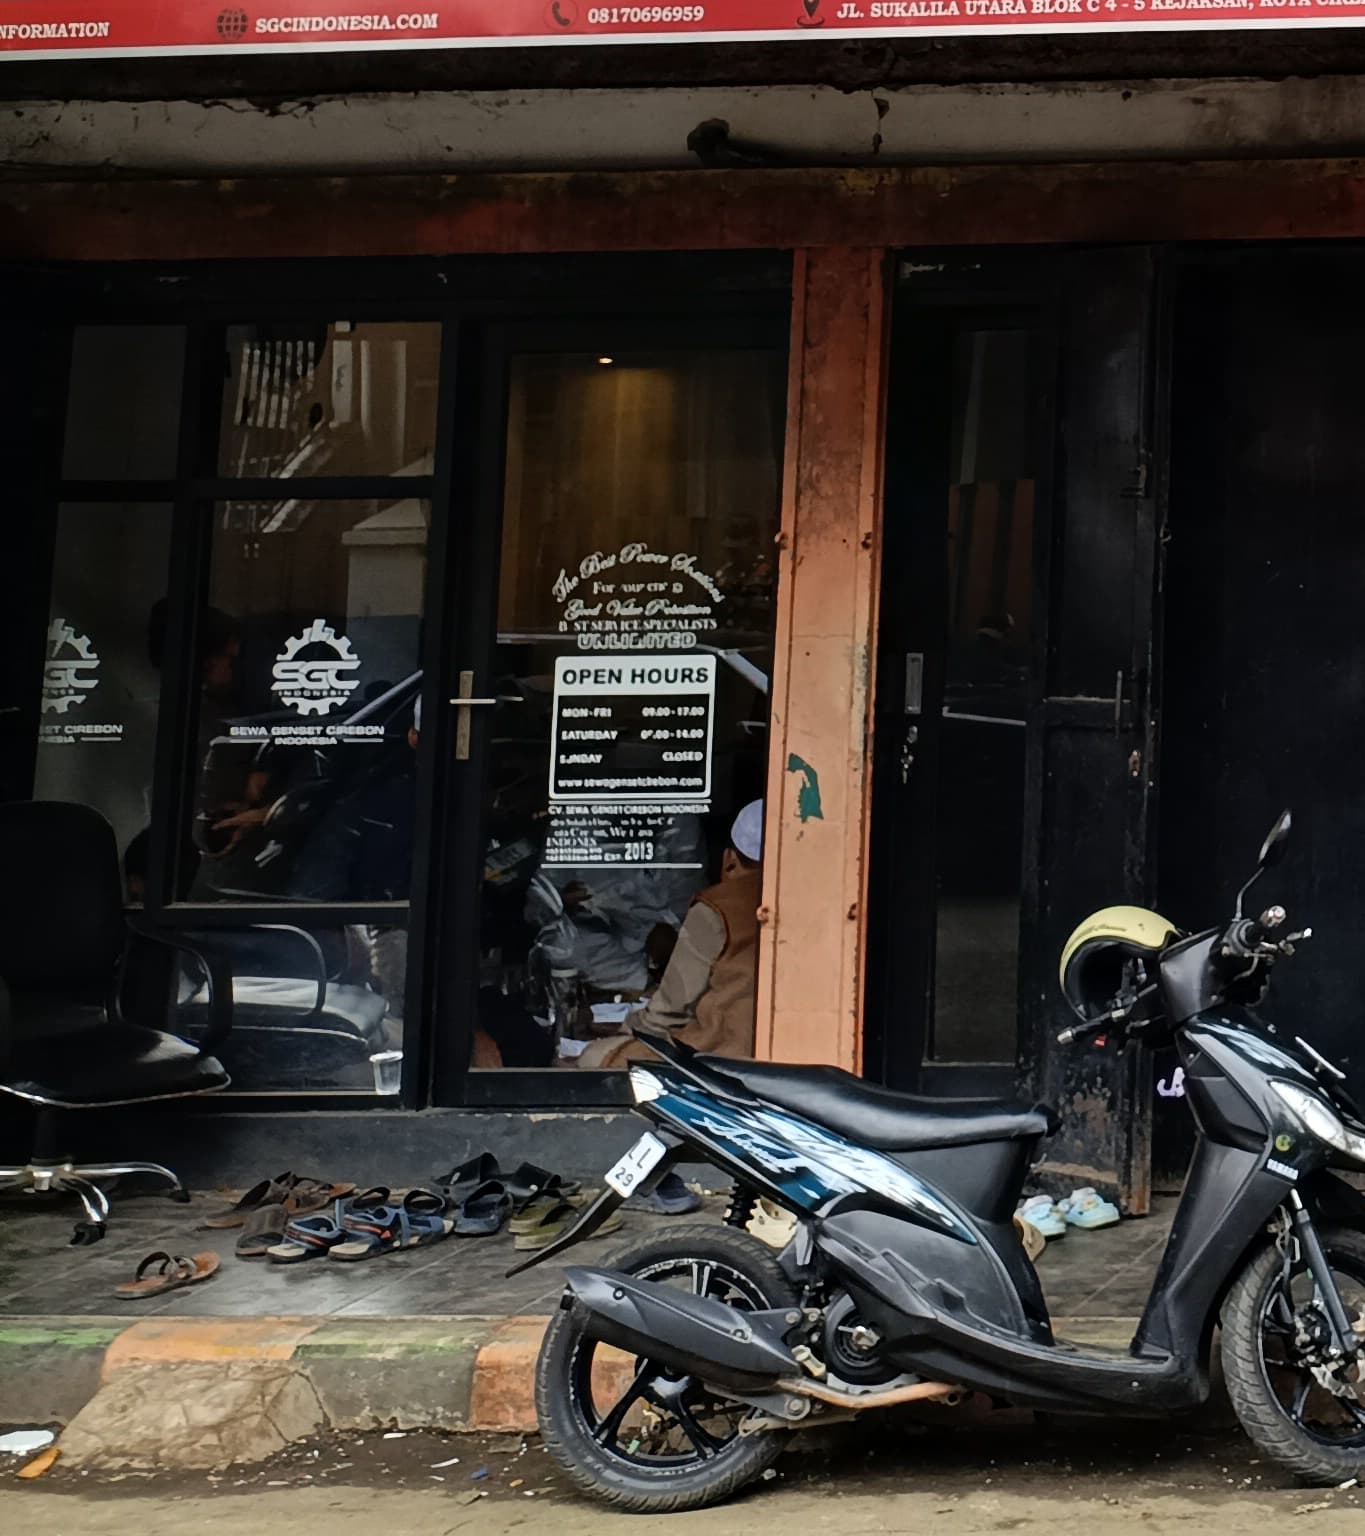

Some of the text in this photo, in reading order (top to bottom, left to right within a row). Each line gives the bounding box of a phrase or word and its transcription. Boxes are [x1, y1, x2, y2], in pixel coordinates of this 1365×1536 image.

[255, 13, 438, 33] SGCINDONESIA.COM
[588, 5, 704, 24] 08170696959
[837, 2, 864, 18] JL.
[870, 0, 960, 18] SUKALILA
[965, 0, 1026, 16] UTARA
[562, 667, 709, 685] OPEN HOURS
[230, 725, 384, 736] SEWA GENSET CIREBON
[561, 730, 618, 740] SATURDAY
[274, 737, 337, 745] INDONESIA
[662, 751, 703, 762] CLOSED
[624, 842, 653, 860] 2013
